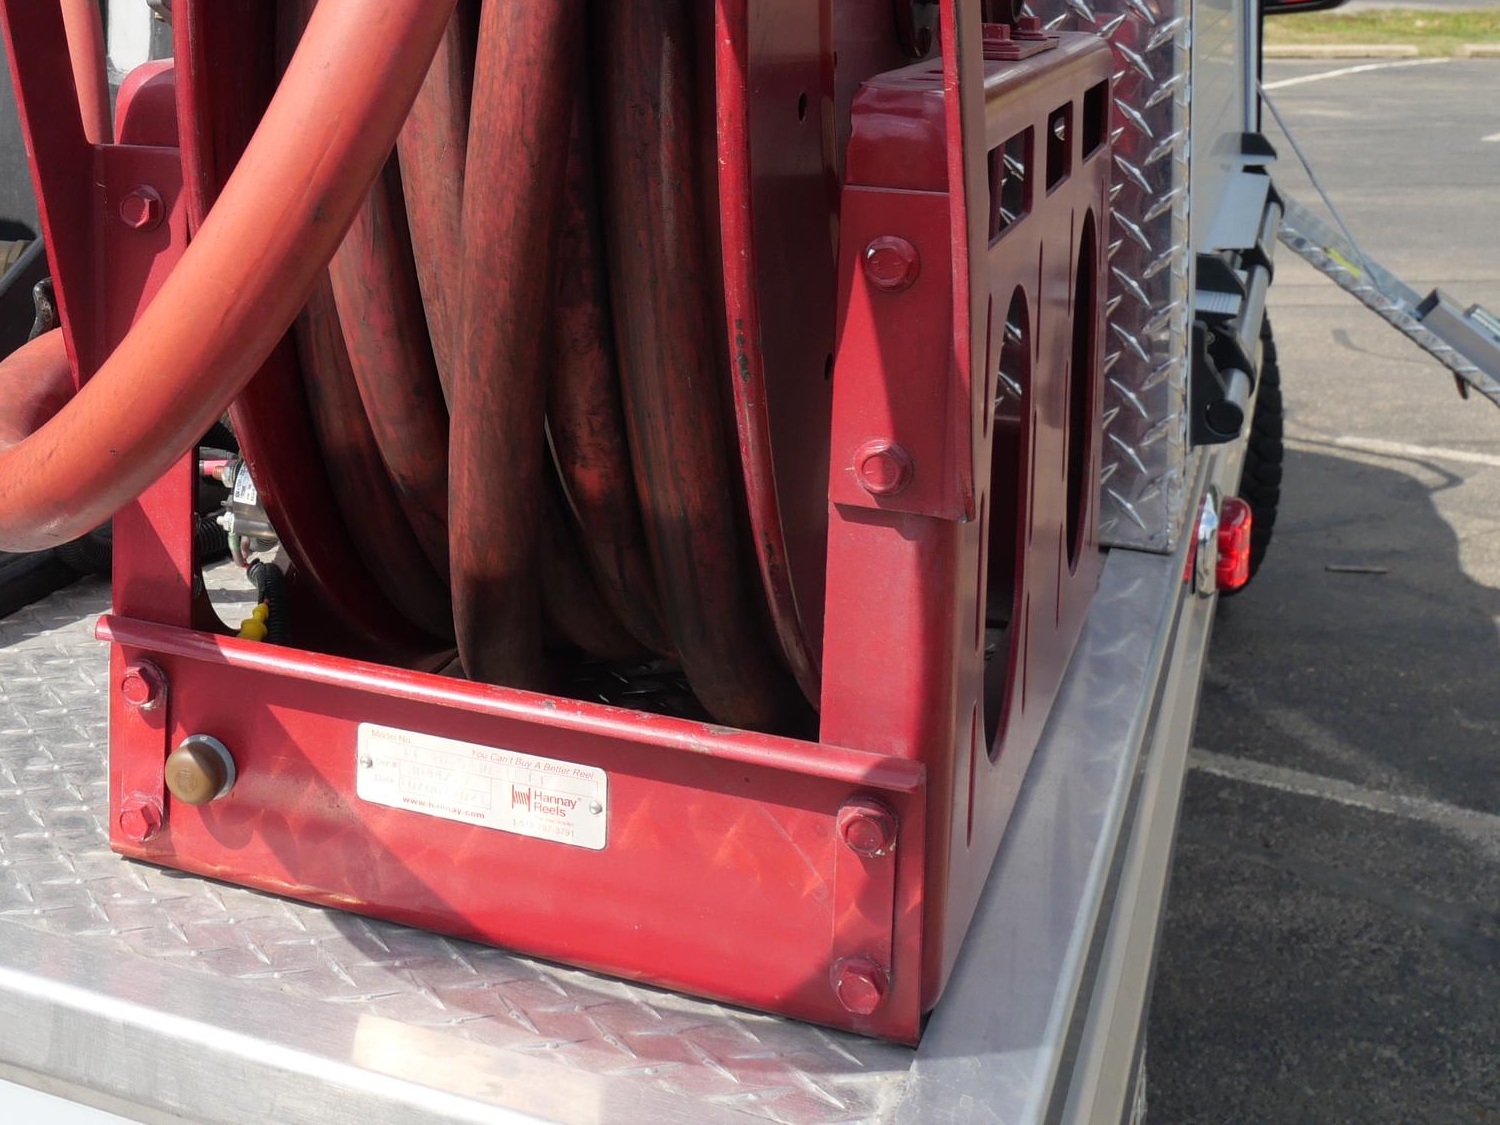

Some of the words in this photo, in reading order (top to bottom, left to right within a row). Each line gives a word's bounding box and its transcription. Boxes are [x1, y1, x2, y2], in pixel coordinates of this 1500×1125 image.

[471, 748, 489, 760] You
[490, 752, 513, 764] Can't
[515, 756, 533, 769] Buy
[543, 762, 571, 775] Better
[572, 768, 595, 780] Reel
[402, 795, 485, 820] www.hannay.com
[534, 790, 578, 810] Hannay
[534, 801, 567, 818] Reels
